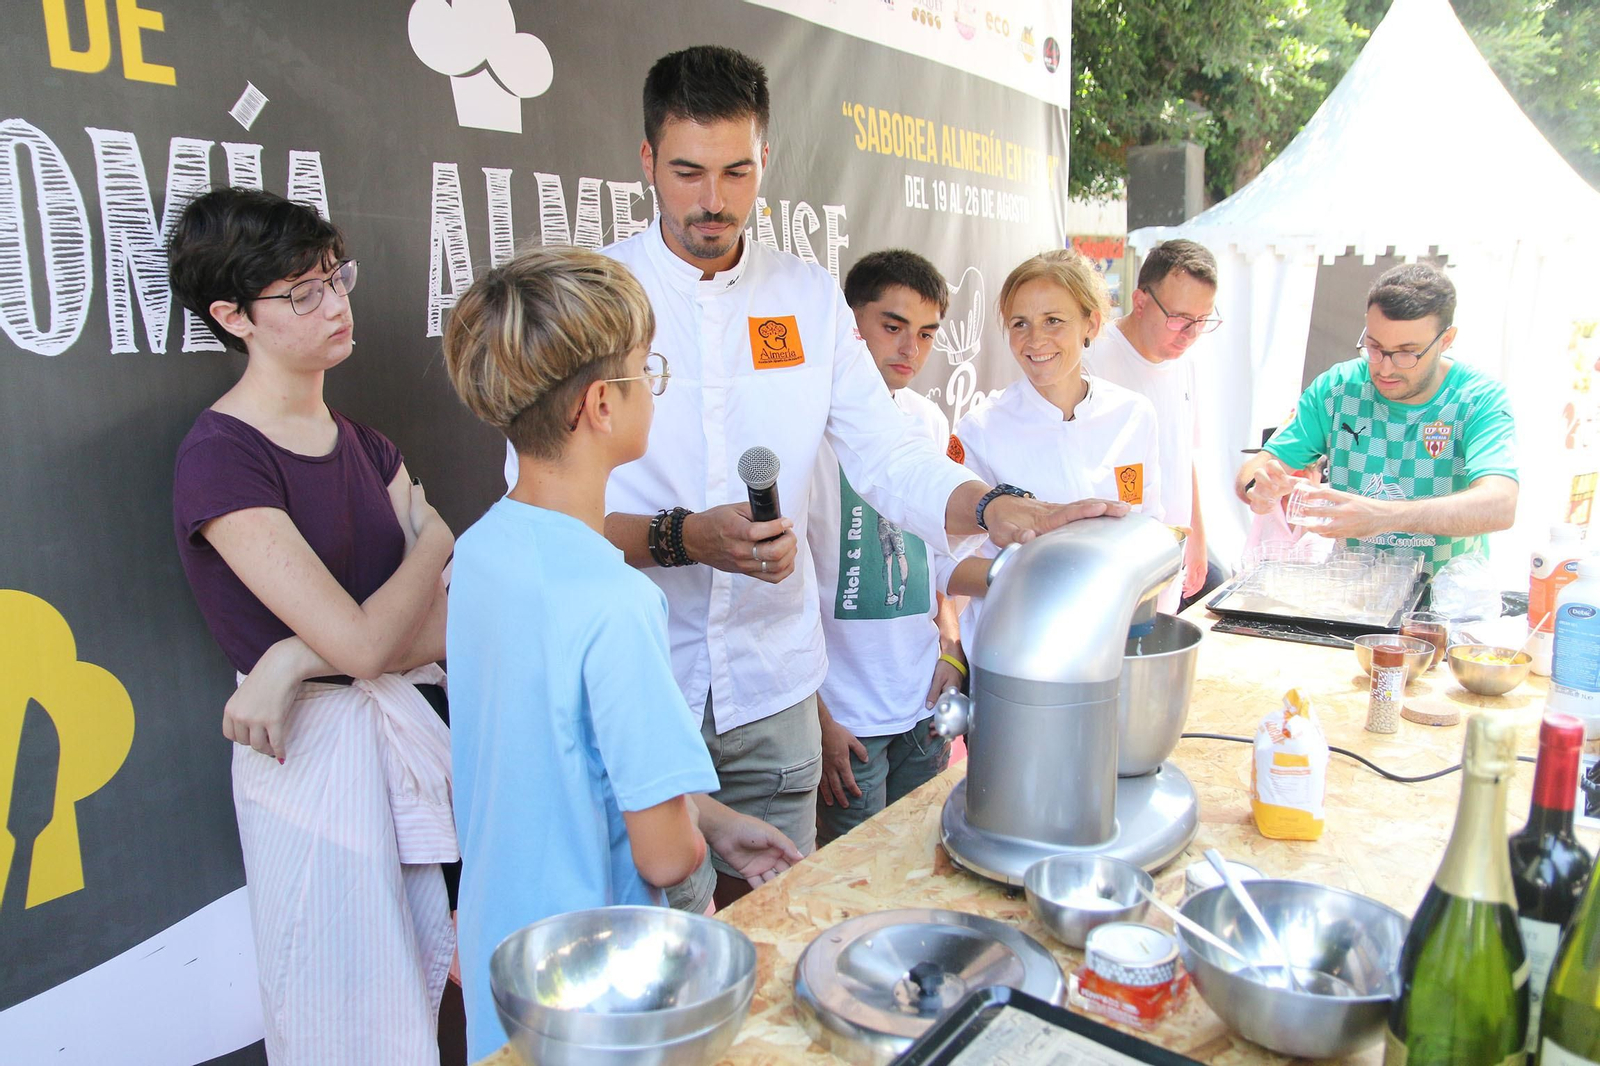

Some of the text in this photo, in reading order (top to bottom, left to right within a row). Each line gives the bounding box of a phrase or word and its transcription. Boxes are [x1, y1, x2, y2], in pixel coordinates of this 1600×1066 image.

[985, 11, 1010, 37] eco
[942, 125, 1004, 178] ALMERÍA
[1006, 141, 1022, 182] EN
[905, 174, 929, 210] DEL
[932, 180, 947, 212] 19
[950, 182, 963, 214] AL
[965, 184, 979, 217] 26
[981, 186, 995, 219] DE
[842, 505, 863, 610] Pitch & Run
[1388, 535, 1436, 547] Centres
[1572, 608, 1592, 617] Debic
